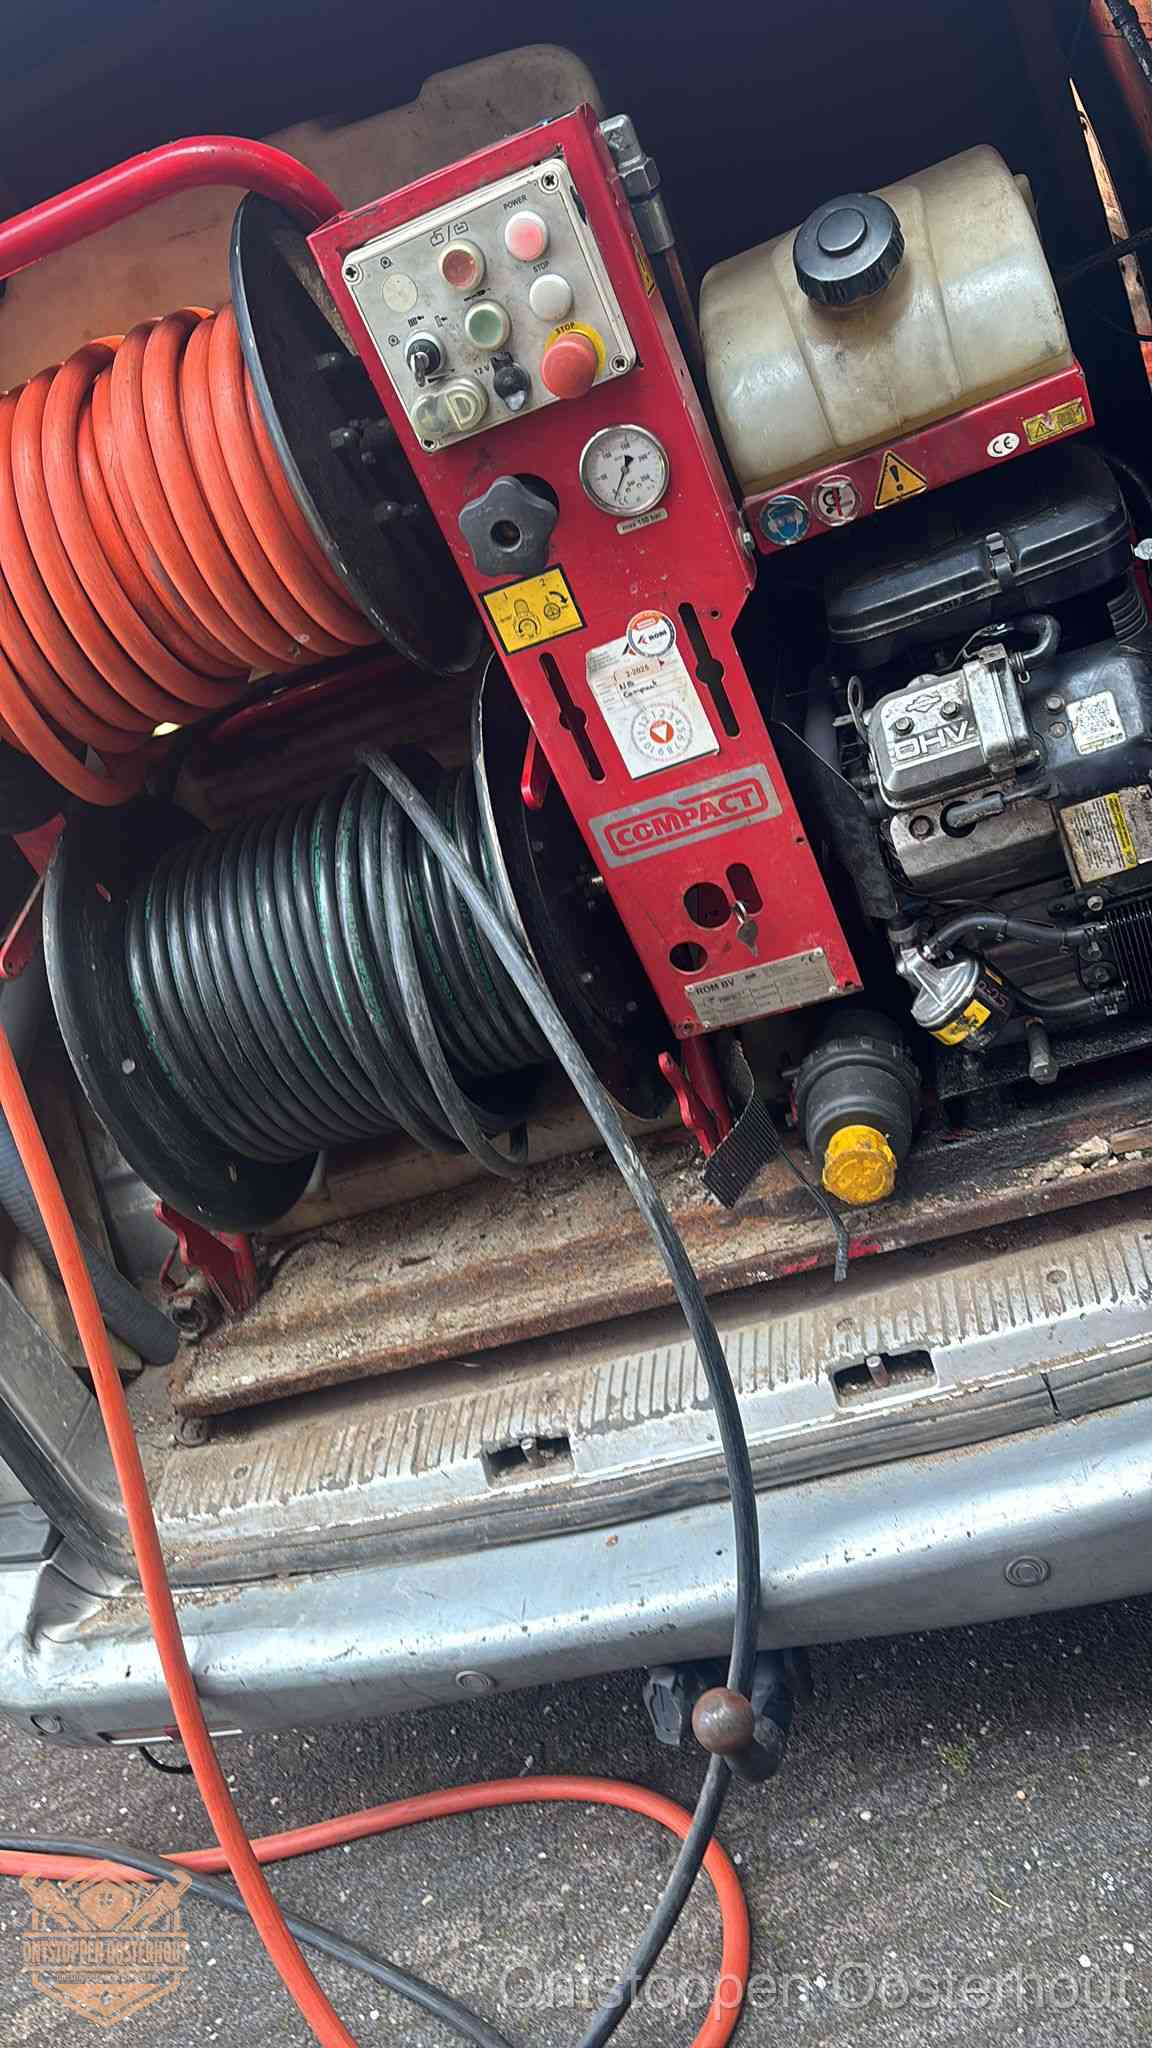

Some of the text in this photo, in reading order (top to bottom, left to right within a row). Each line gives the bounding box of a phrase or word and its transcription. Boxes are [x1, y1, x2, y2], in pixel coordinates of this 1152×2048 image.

[503, 194, 528, 210] POWER
[533, 260, 550, 273] STOP
[555, 321, 576, 335] STOP
[895, 720, 969, 760] OHV
[616, 787, 754, 847] COMPACT
